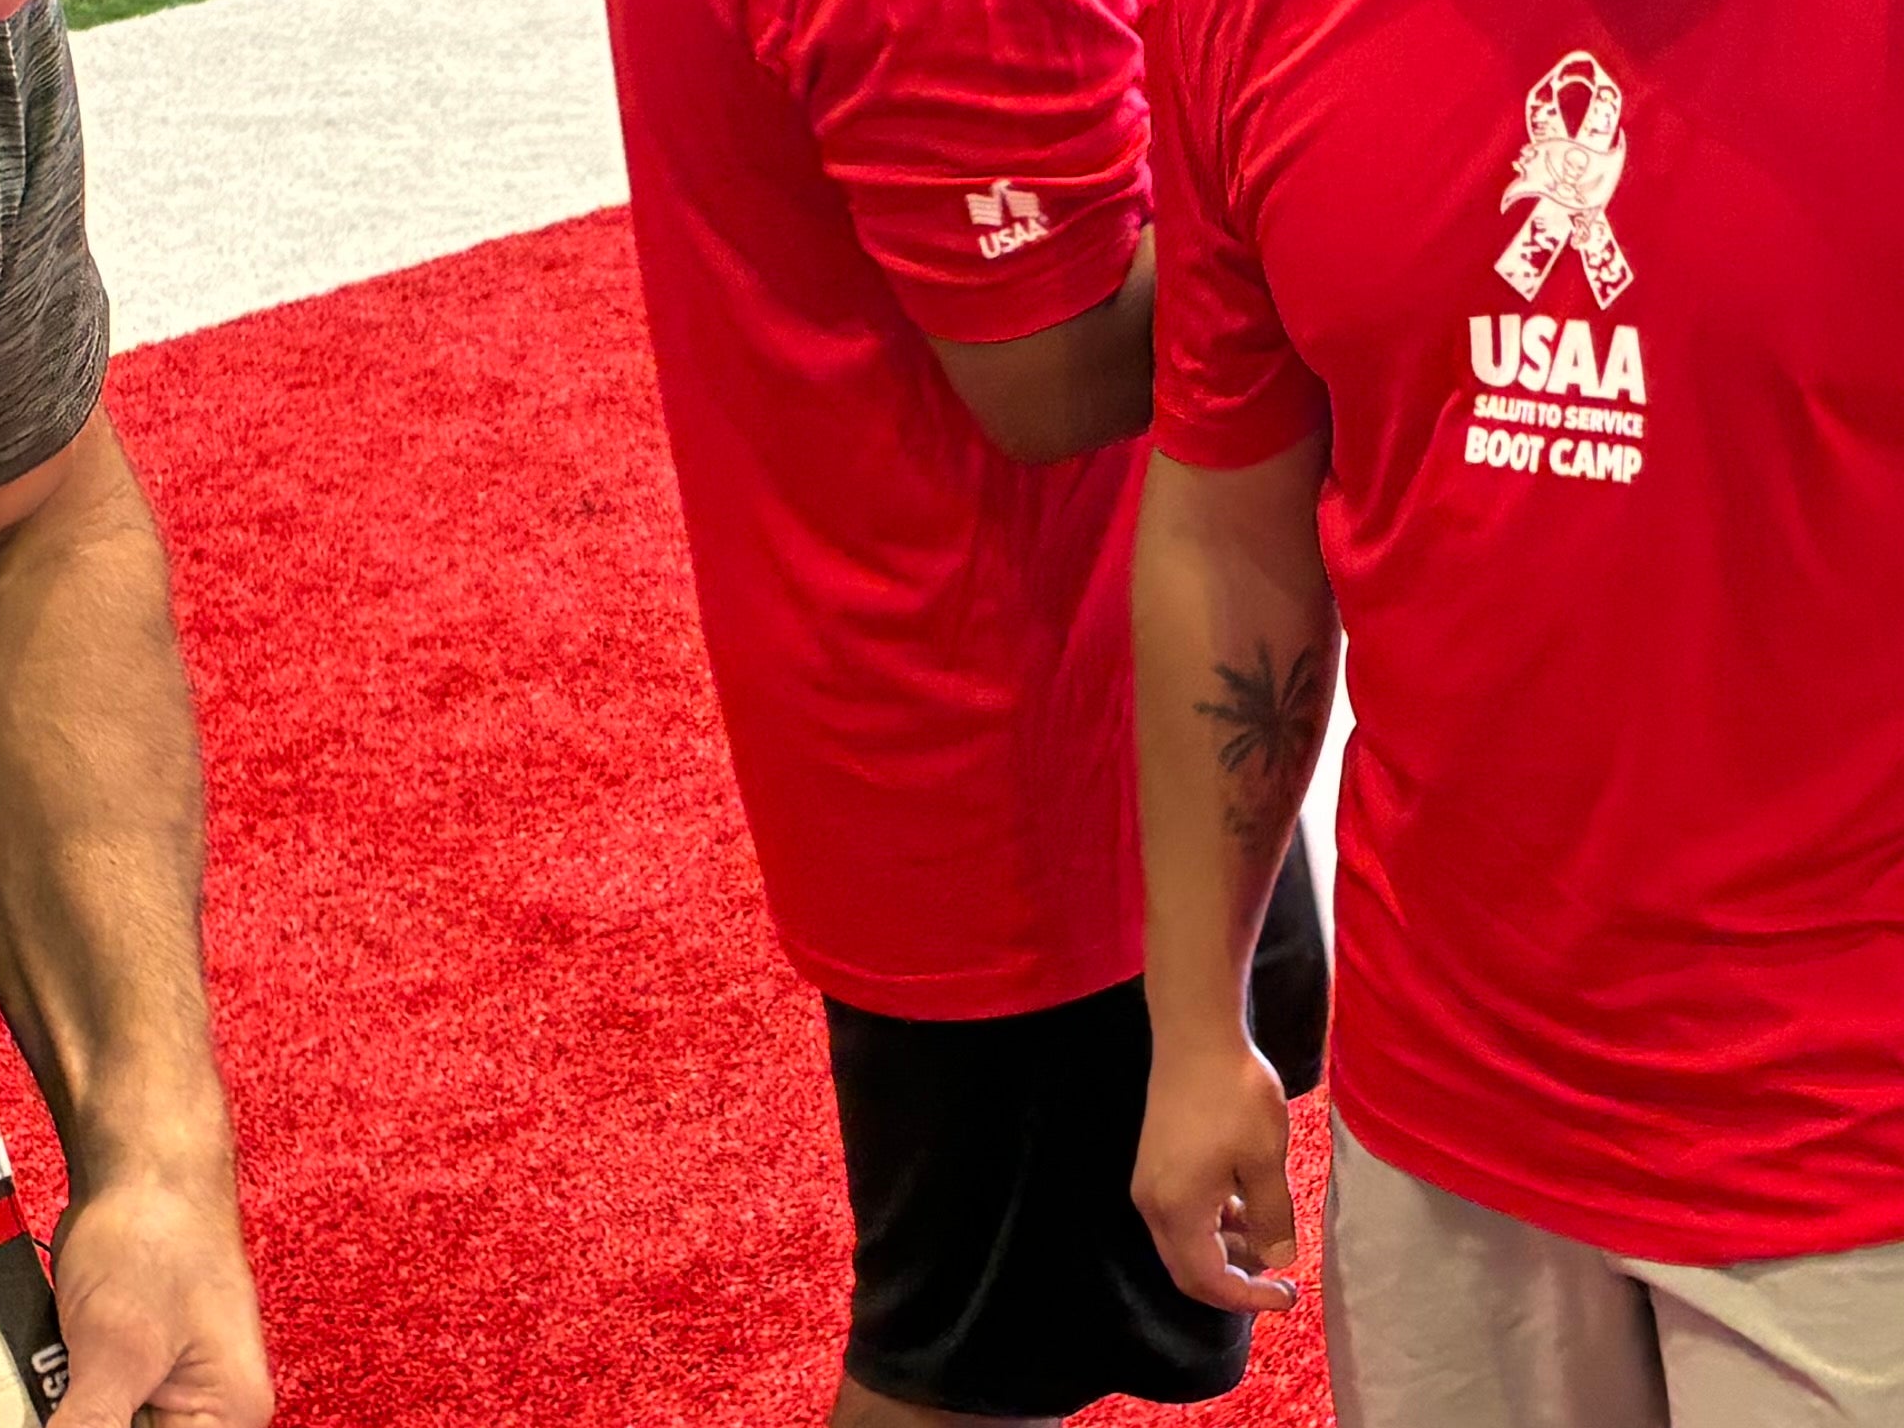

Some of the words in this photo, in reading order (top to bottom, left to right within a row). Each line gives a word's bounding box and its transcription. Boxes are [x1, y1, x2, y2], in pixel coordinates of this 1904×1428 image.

[977, 217, 1049, 260] USAA
[1468, 313, 1647, 405] USAA
[1473, 394, 1537, 426] SALUTE
[1537, 403, 1562, 428] TO
[1564, 404, 1644, 438] SERVICE
[1464, 425, 1546, 475] BOOT
[1548, 437, 1643, 484] CAMP
